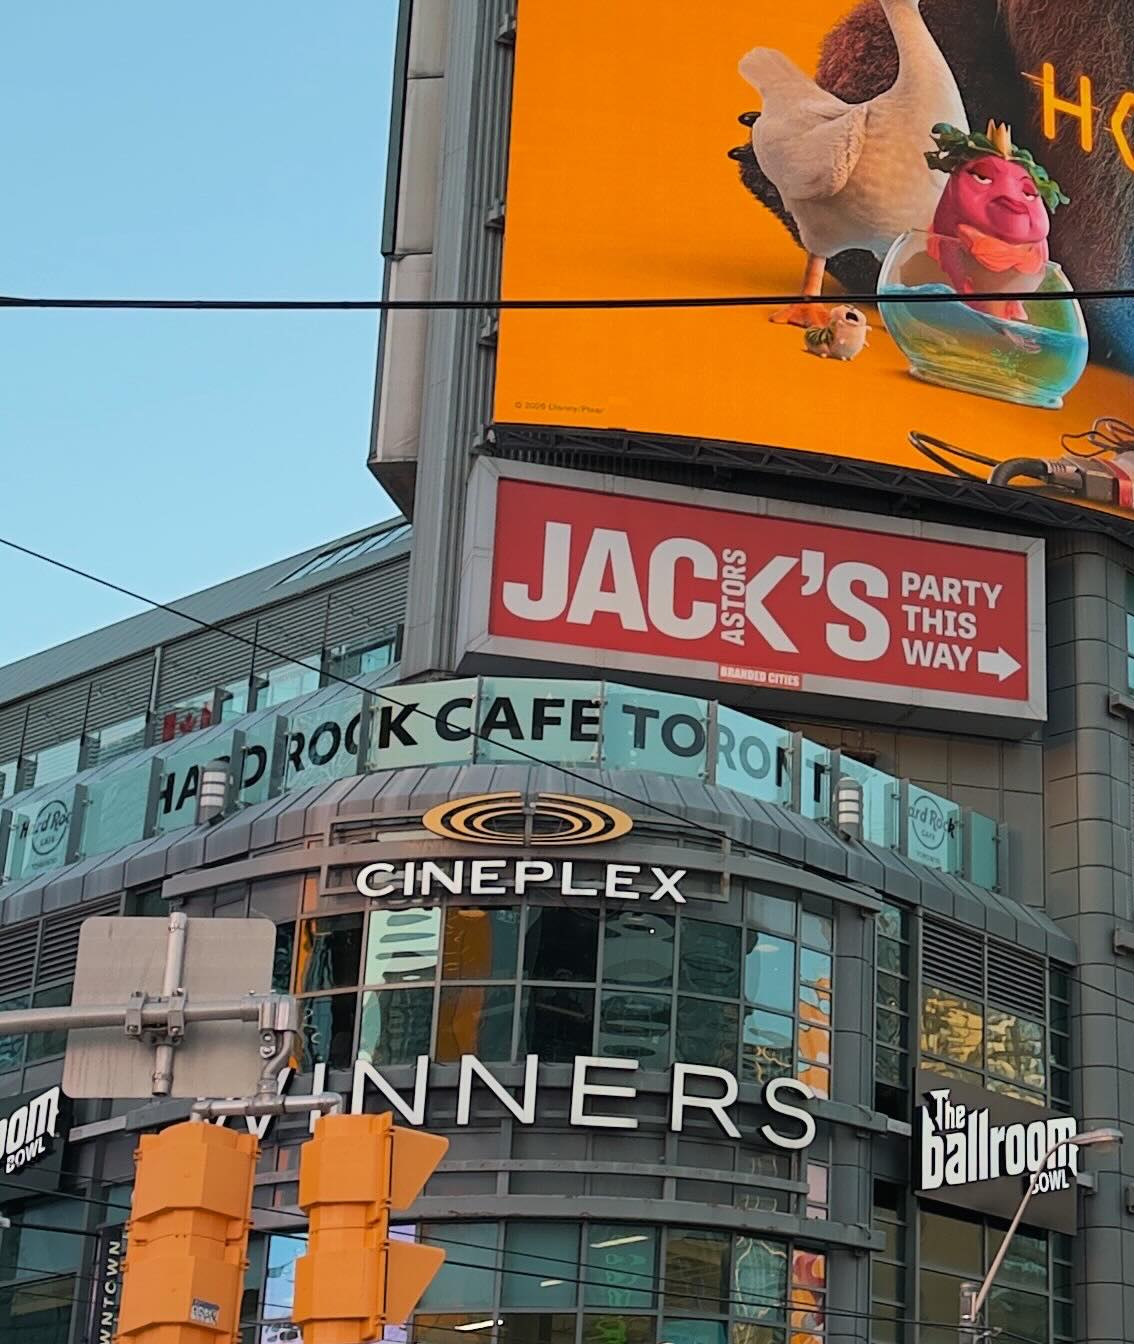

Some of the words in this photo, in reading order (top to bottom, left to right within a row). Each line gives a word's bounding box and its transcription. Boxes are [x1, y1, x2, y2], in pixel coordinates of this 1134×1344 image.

[501, 521, 891, 663] JACK'S
[720, 548, 747, 647] ASTORS
[901, 570, 1004, 610] PARTY
[901, 604, 978, 640] THIS
[720, 665, 767, 682] BRANDED
[767, 672, 801, 687] CITIES
[902, 638, 974, 674] WAY
[159, 745, 267, 815] HAD
[435, 695, 602, 742] CAFE
[355, 858, 688, 904] CINEPLEX
[930, 1088, 966, 1131] The
[5, 1137, 46, 1175] BOWL
[921, 1105, 1080, 1190] ballroom
